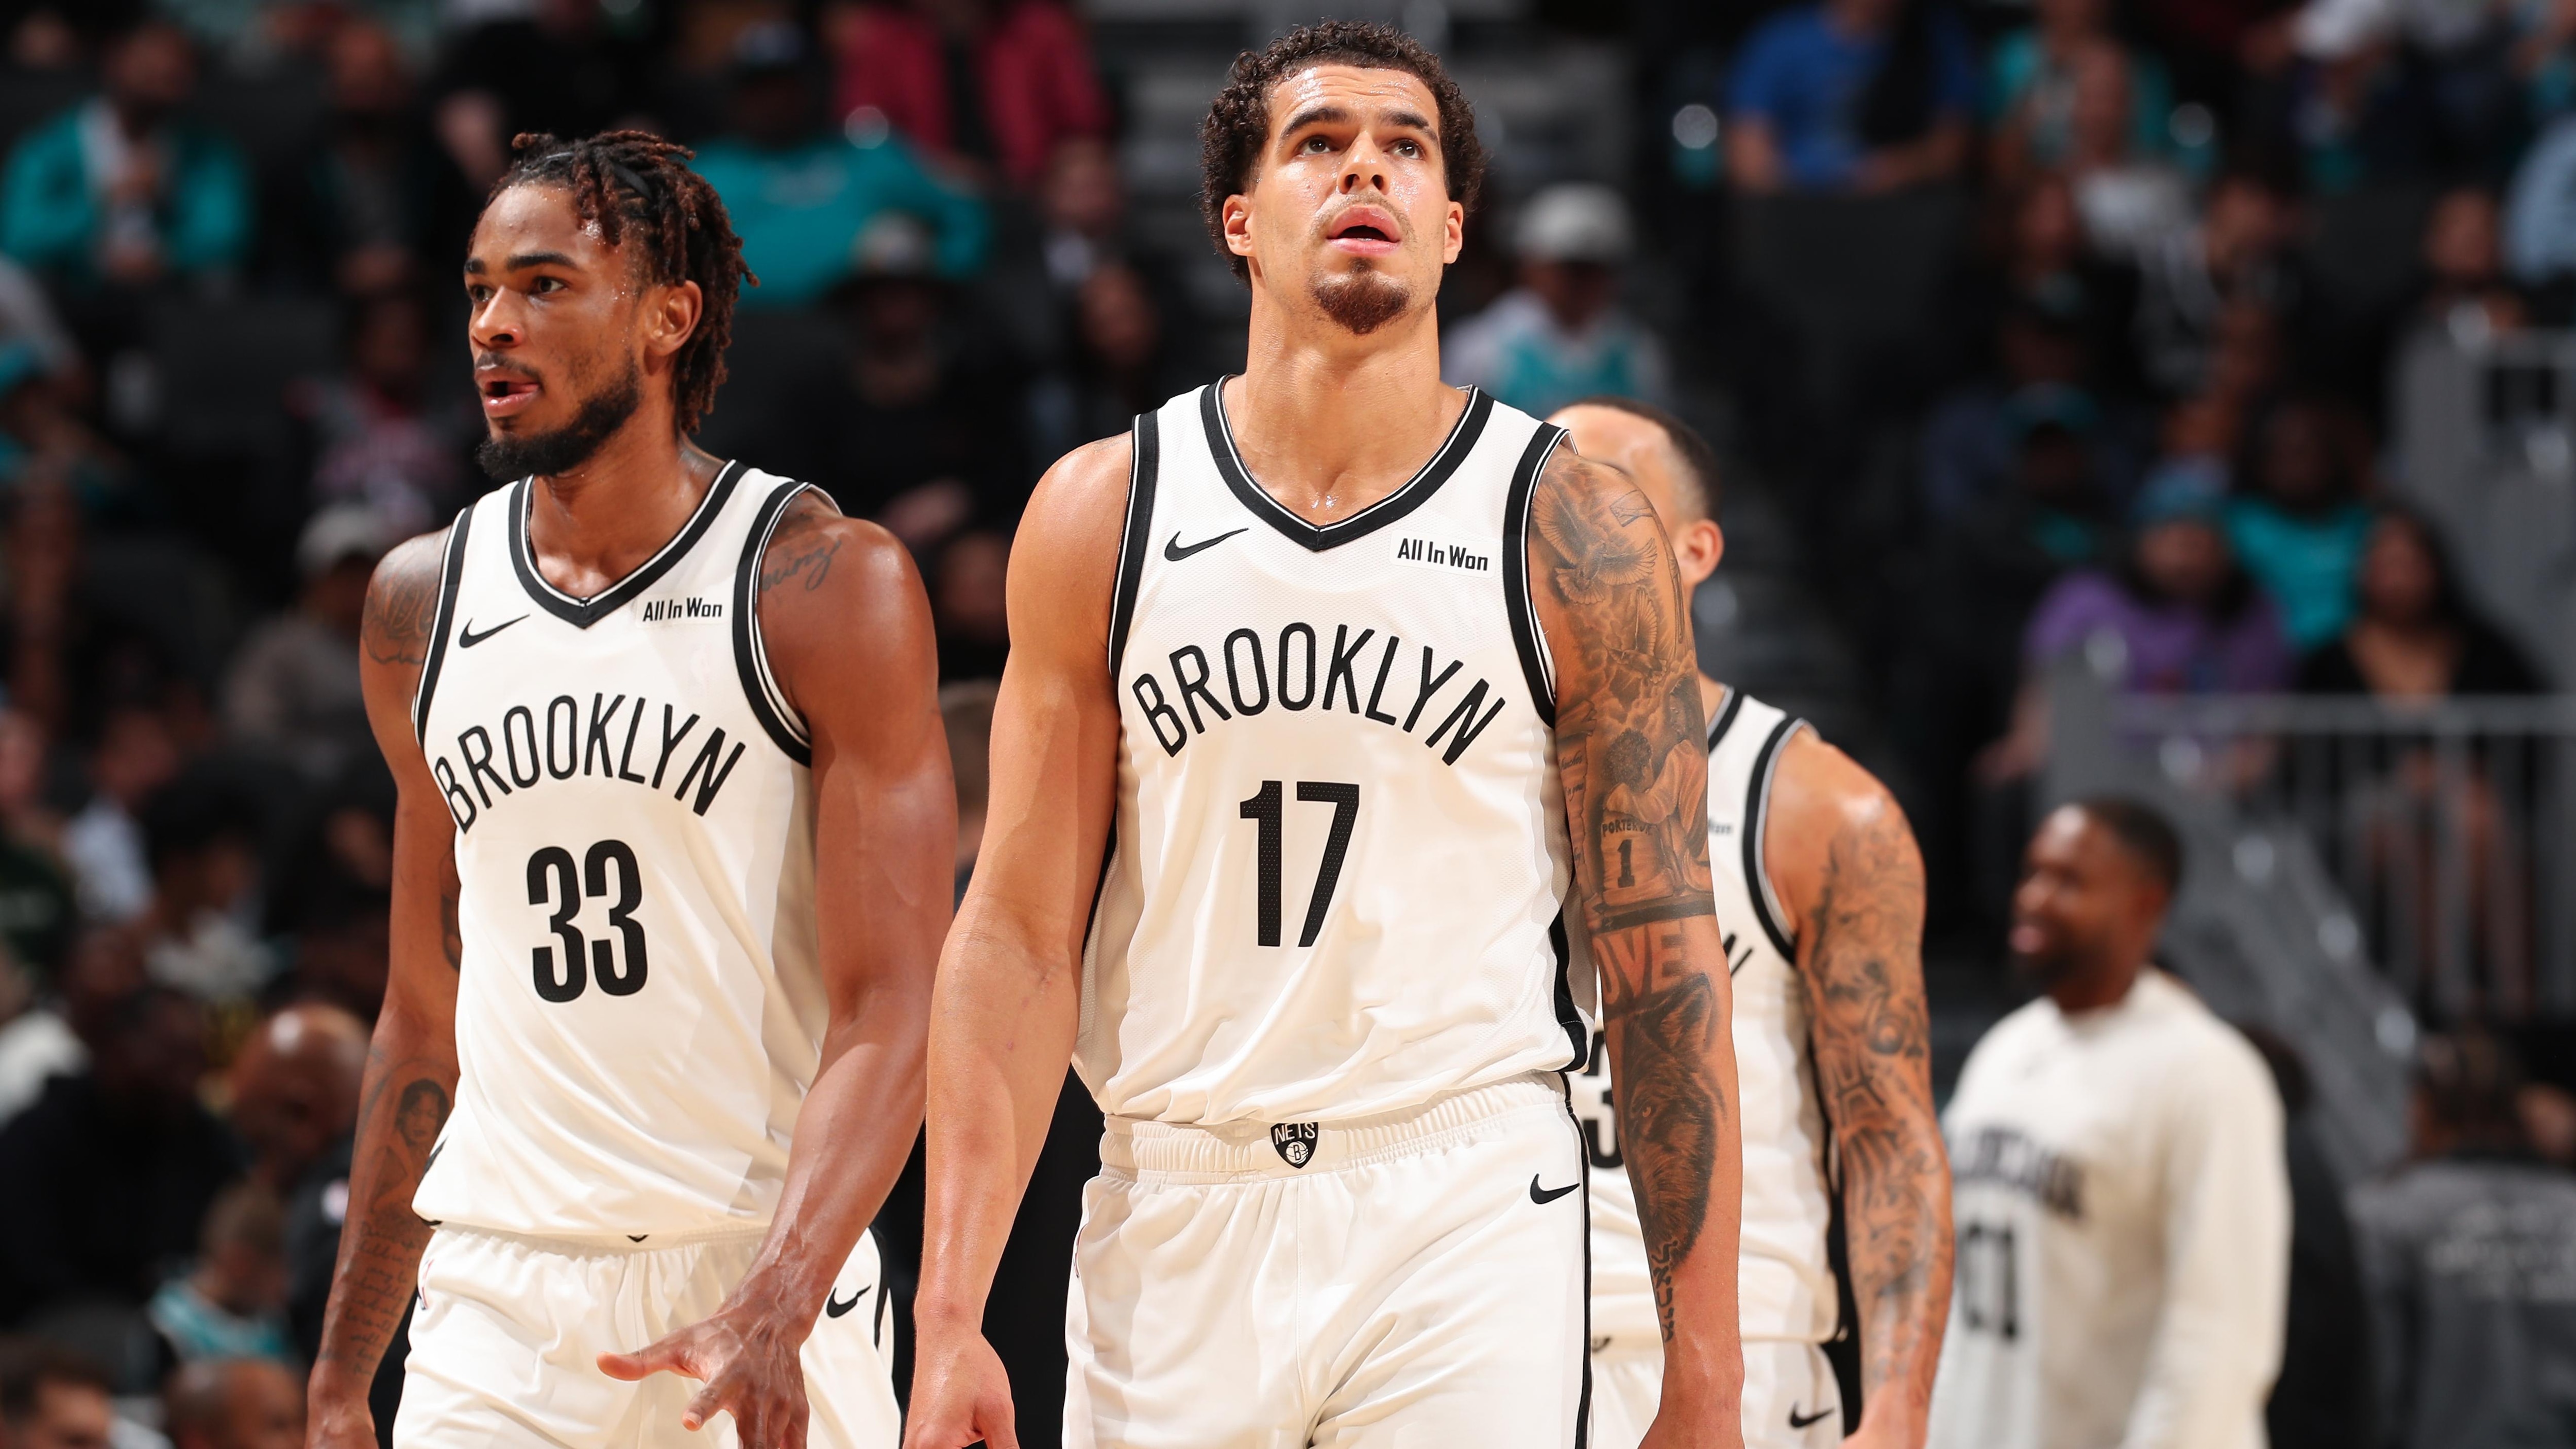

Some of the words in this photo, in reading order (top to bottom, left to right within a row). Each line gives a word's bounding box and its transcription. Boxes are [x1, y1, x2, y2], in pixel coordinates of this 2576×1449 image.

[1397, 538, 1423, 560] All
[1428, 541, 1445, 564] In
[1449, 544, 1488, 571] Won
[642, 601, 665, 622] All
[667, 599, 682, 619] In
[687, 597, 722, 617] Won
[1132, 622, 1505, 766] BROOKLYN
[434, 692, 746, 834] BROOKLYN
[1240, 780, 1360, 947] 17
[1617, 839, 1635, 888] 1
[527, 839, 648, 1003] 33
[1592, 921, 1683, 1004] OVE
[1275, 1122, 1316, 1145] NETS
[1293, 1144, 1302, 1161] B
